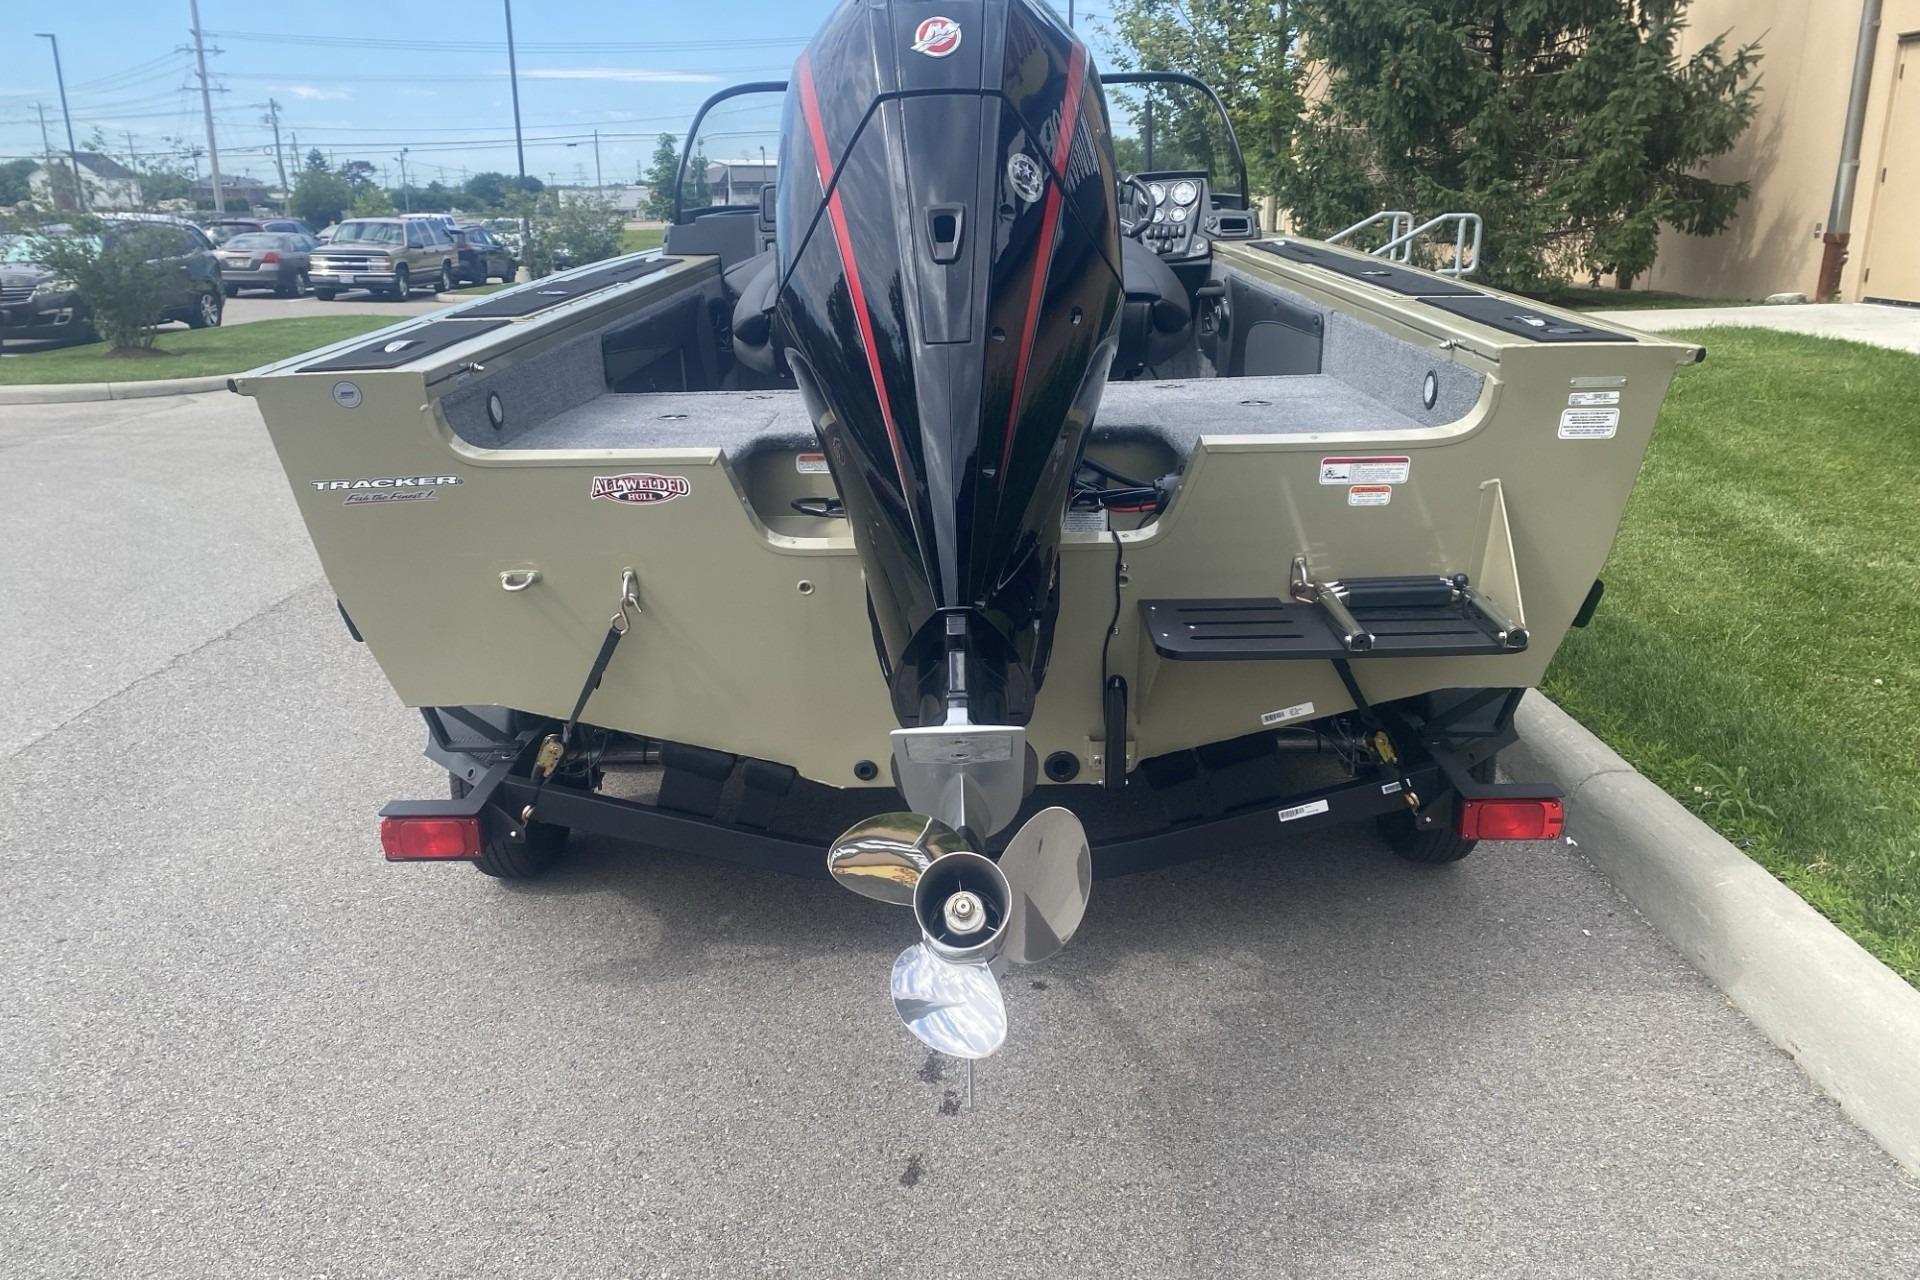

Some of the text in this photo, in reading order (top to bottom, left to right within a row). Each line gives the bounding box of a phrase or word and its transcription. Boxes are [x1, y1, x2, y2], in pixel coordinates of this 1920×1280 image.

[311, 475, 458, 491] TRACKER
[593, 478, 689, 497] ALL WELDED
[628, 492, 656, 501] HULL
